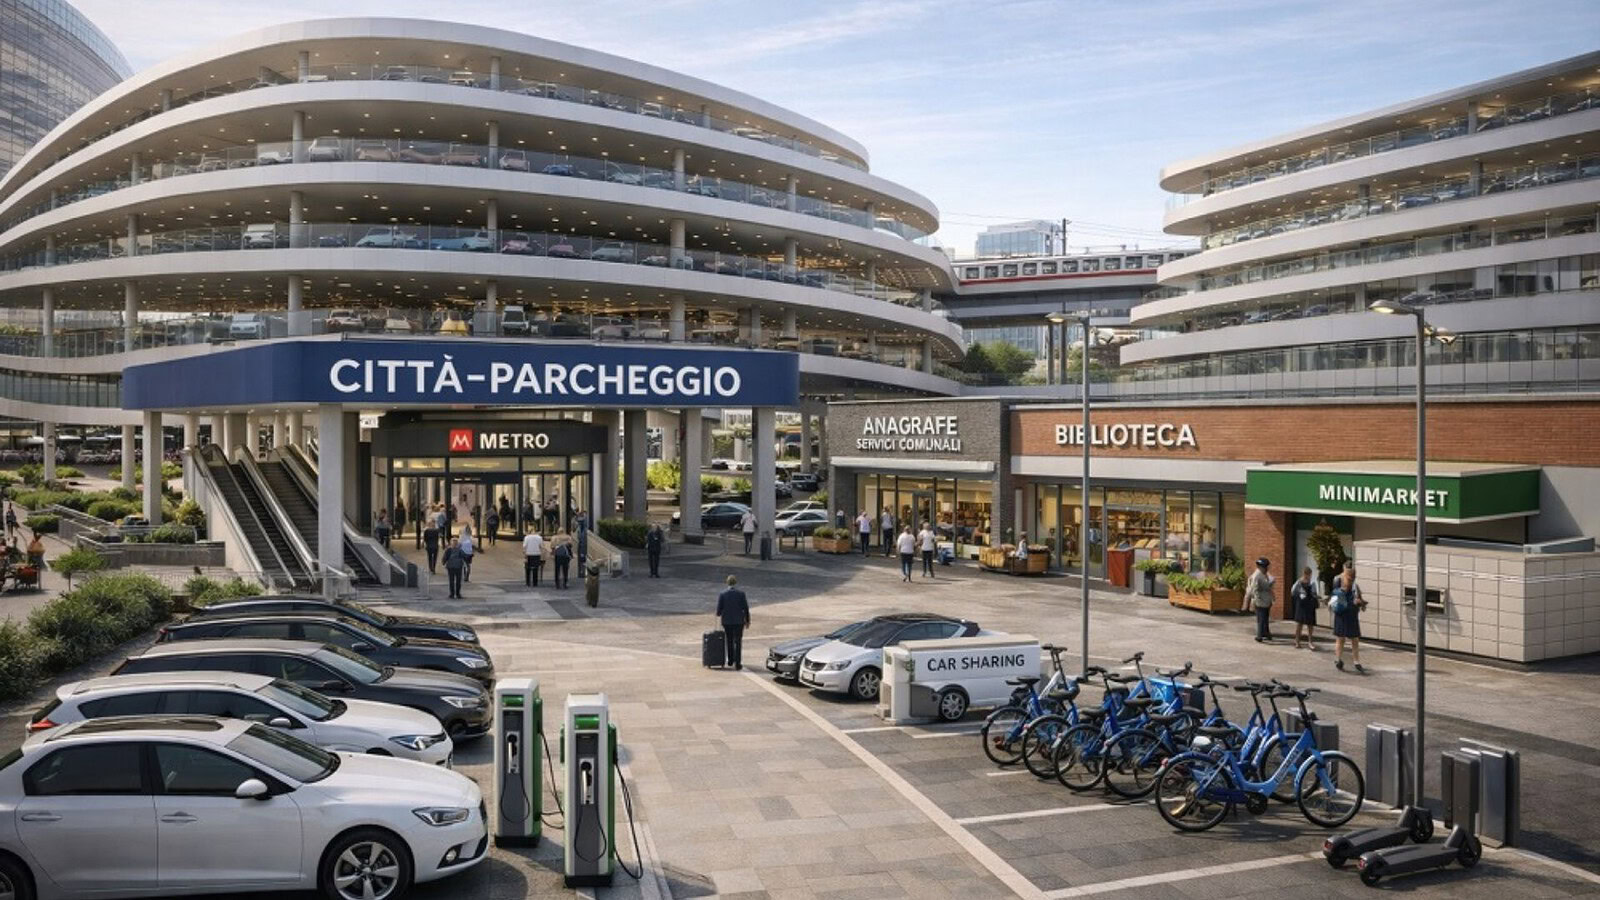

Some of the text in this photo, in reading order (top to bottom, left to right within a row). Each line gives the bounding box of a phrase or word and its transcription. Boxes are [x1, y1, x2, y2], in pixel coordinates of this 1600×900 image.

[329, 353, 742, 397] CITTÀ-PARCHEGGIO
[863, 415, 958, 436] ANAGRAFE
[1055, 423, 1196, 446] BIBLIOTECA
[452, 432, 550, 450] M METRO
[898, 437, 961, 451] COMUNALI
[1319, 484, 1449, 507] MINIMARKET
[927, 654, 1025, 671] CAR SHARING
